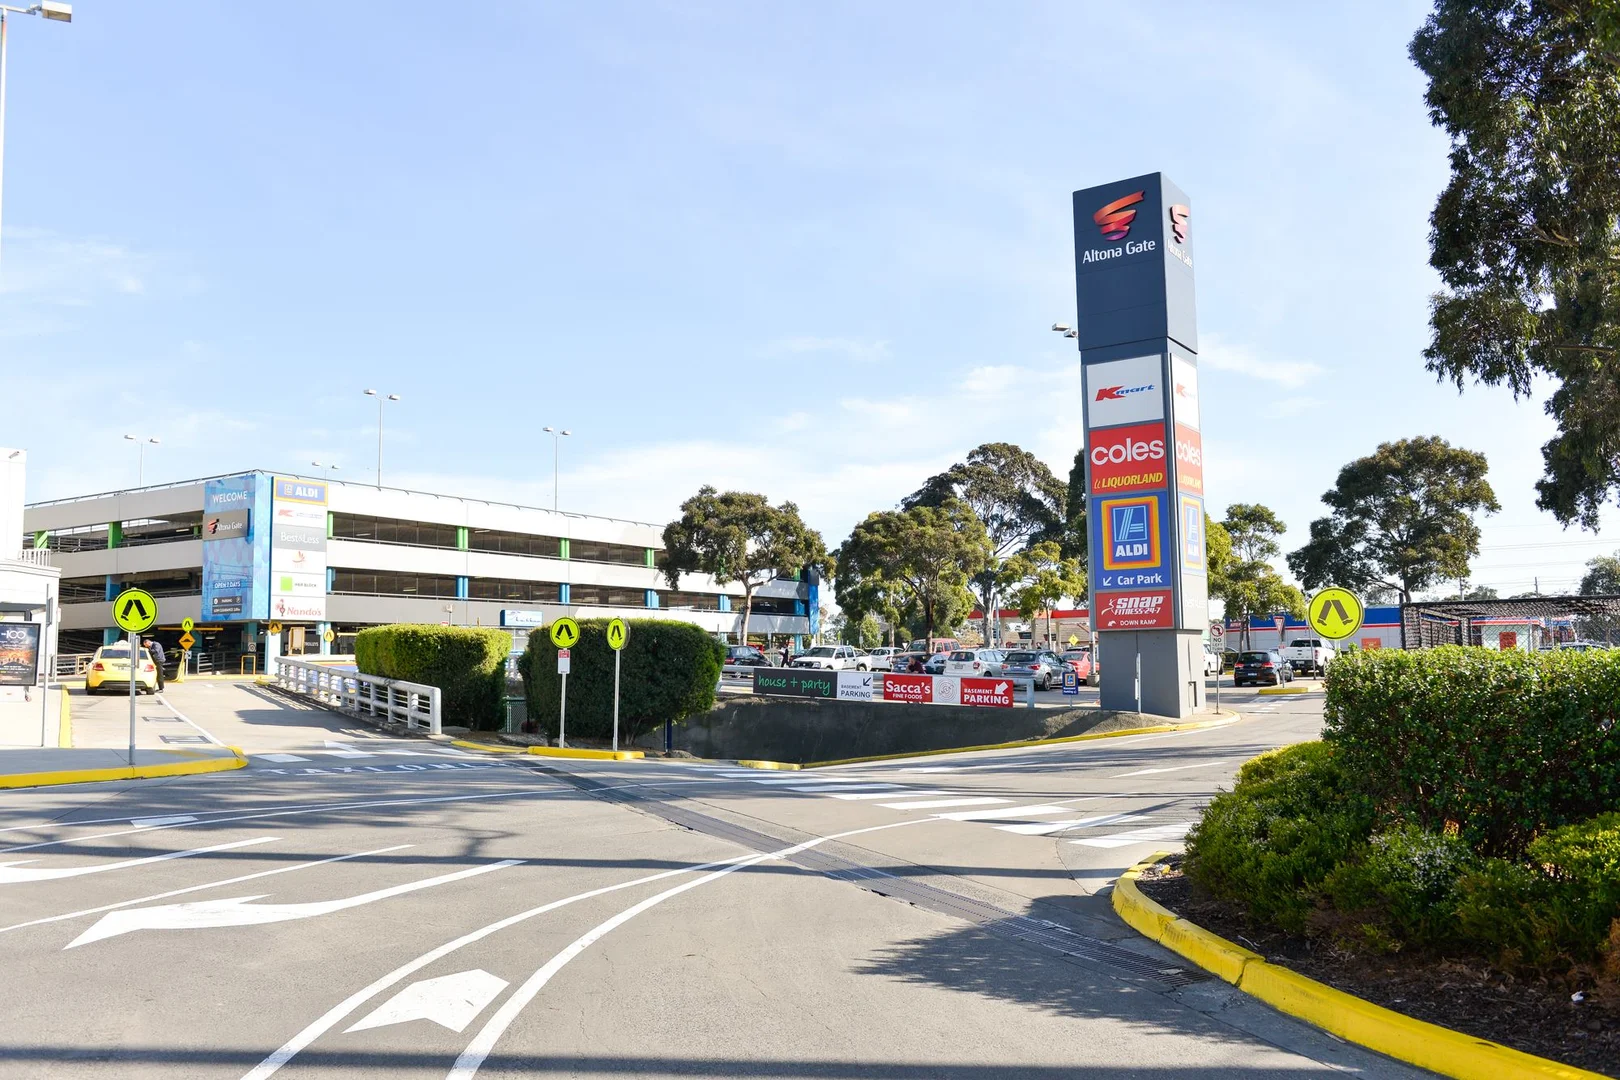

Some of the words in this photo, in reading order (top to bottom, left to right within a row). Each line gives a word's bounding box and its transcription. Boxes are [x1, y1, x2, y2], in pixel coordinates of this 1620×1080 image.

[1082, 247, 1122, 264] Altona
[1125, 240, 1156, 255] Gate
[1095, 384, 1155, 402] Kmart
[1090, 438, 1165, 466] coles
[1177, 440, 1201, 467] coles
[1101, 472, 1163, 488] LIQUORLAND
[212, 490, 248, 503] WELCOME
[295, 486, 318, 498] ALDI
[231, 521, 243, 530] Gate
[1115, 543, 1148, 557] ALDI
[1117, 576, 1135, 586] Car
[1137, 573, 1163, 584] Park
[286, 606, 322, 616] Nando's
[6, 630, 26, 640] 100
[758, 675, 787, 688] house
[801, 679, 831, 696] party
[885, 680, 931, 694] Sacca's
[840, 690, 871, 698] PARKING
[963, 695, 1010, 704] PARKING
[260, 766, 384, 775] TAXI
